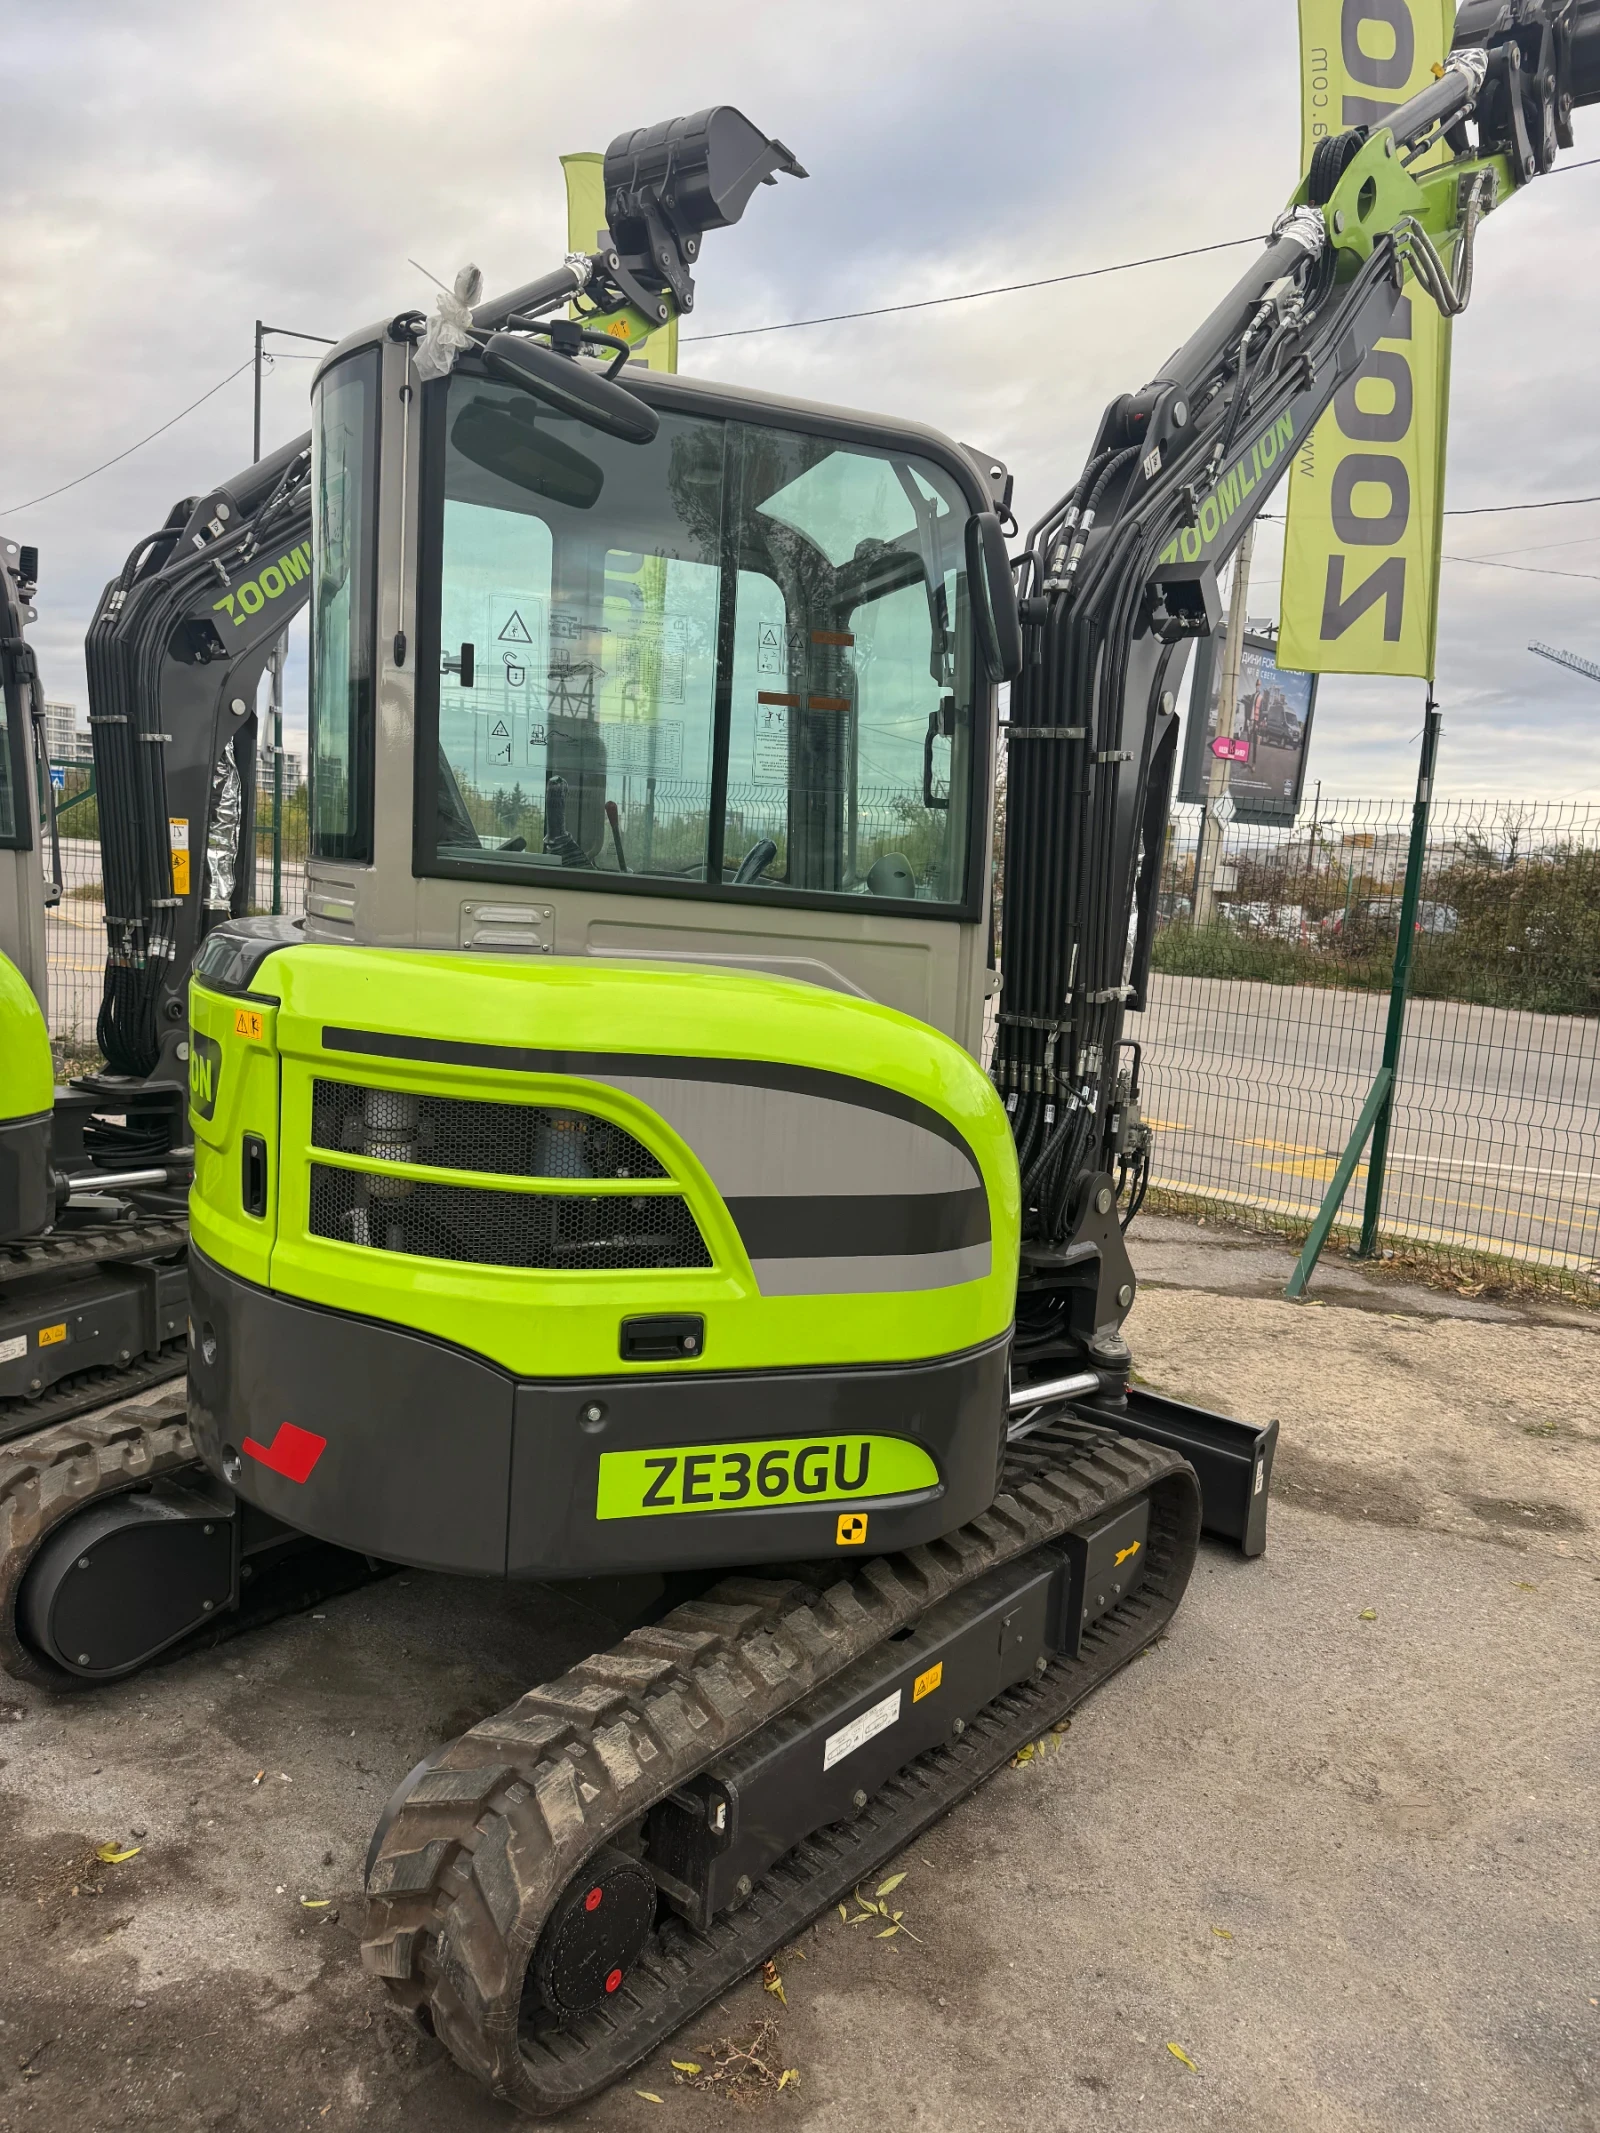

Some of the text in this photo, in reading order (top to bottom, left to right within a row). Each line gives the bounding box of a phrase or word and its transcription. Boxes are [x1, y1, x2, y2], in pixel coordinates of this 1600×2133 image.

[1159, 408, 1295, 564] ZOOMLION
[1242, 652, 1277, 670] ДИНИ FOR
[642, 1442, 871, 1507] ZE36GU
